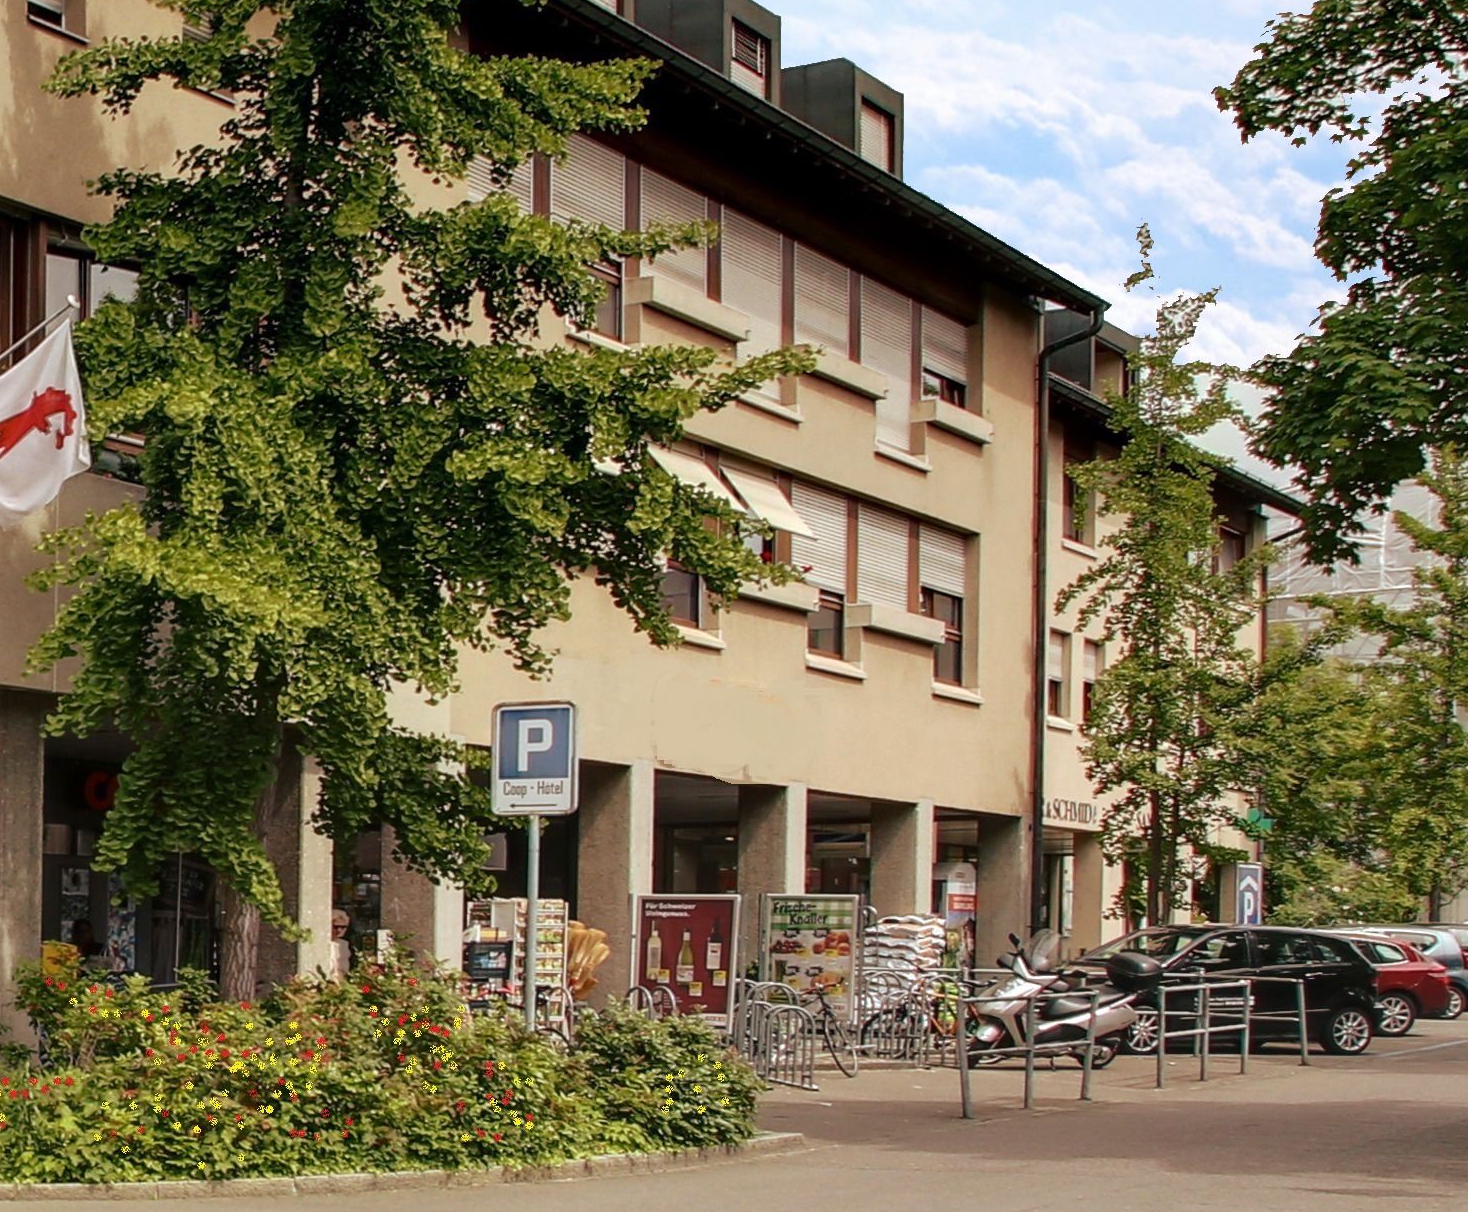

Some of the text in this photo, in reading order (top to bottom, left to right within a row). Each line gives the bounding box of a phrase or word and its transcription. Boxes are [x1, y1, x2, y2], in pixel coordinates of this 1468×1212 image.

[518, 719, 553, 772] P
[503, 781, 527, 799] Coop
[790, 913, 828, 925] Knaller
